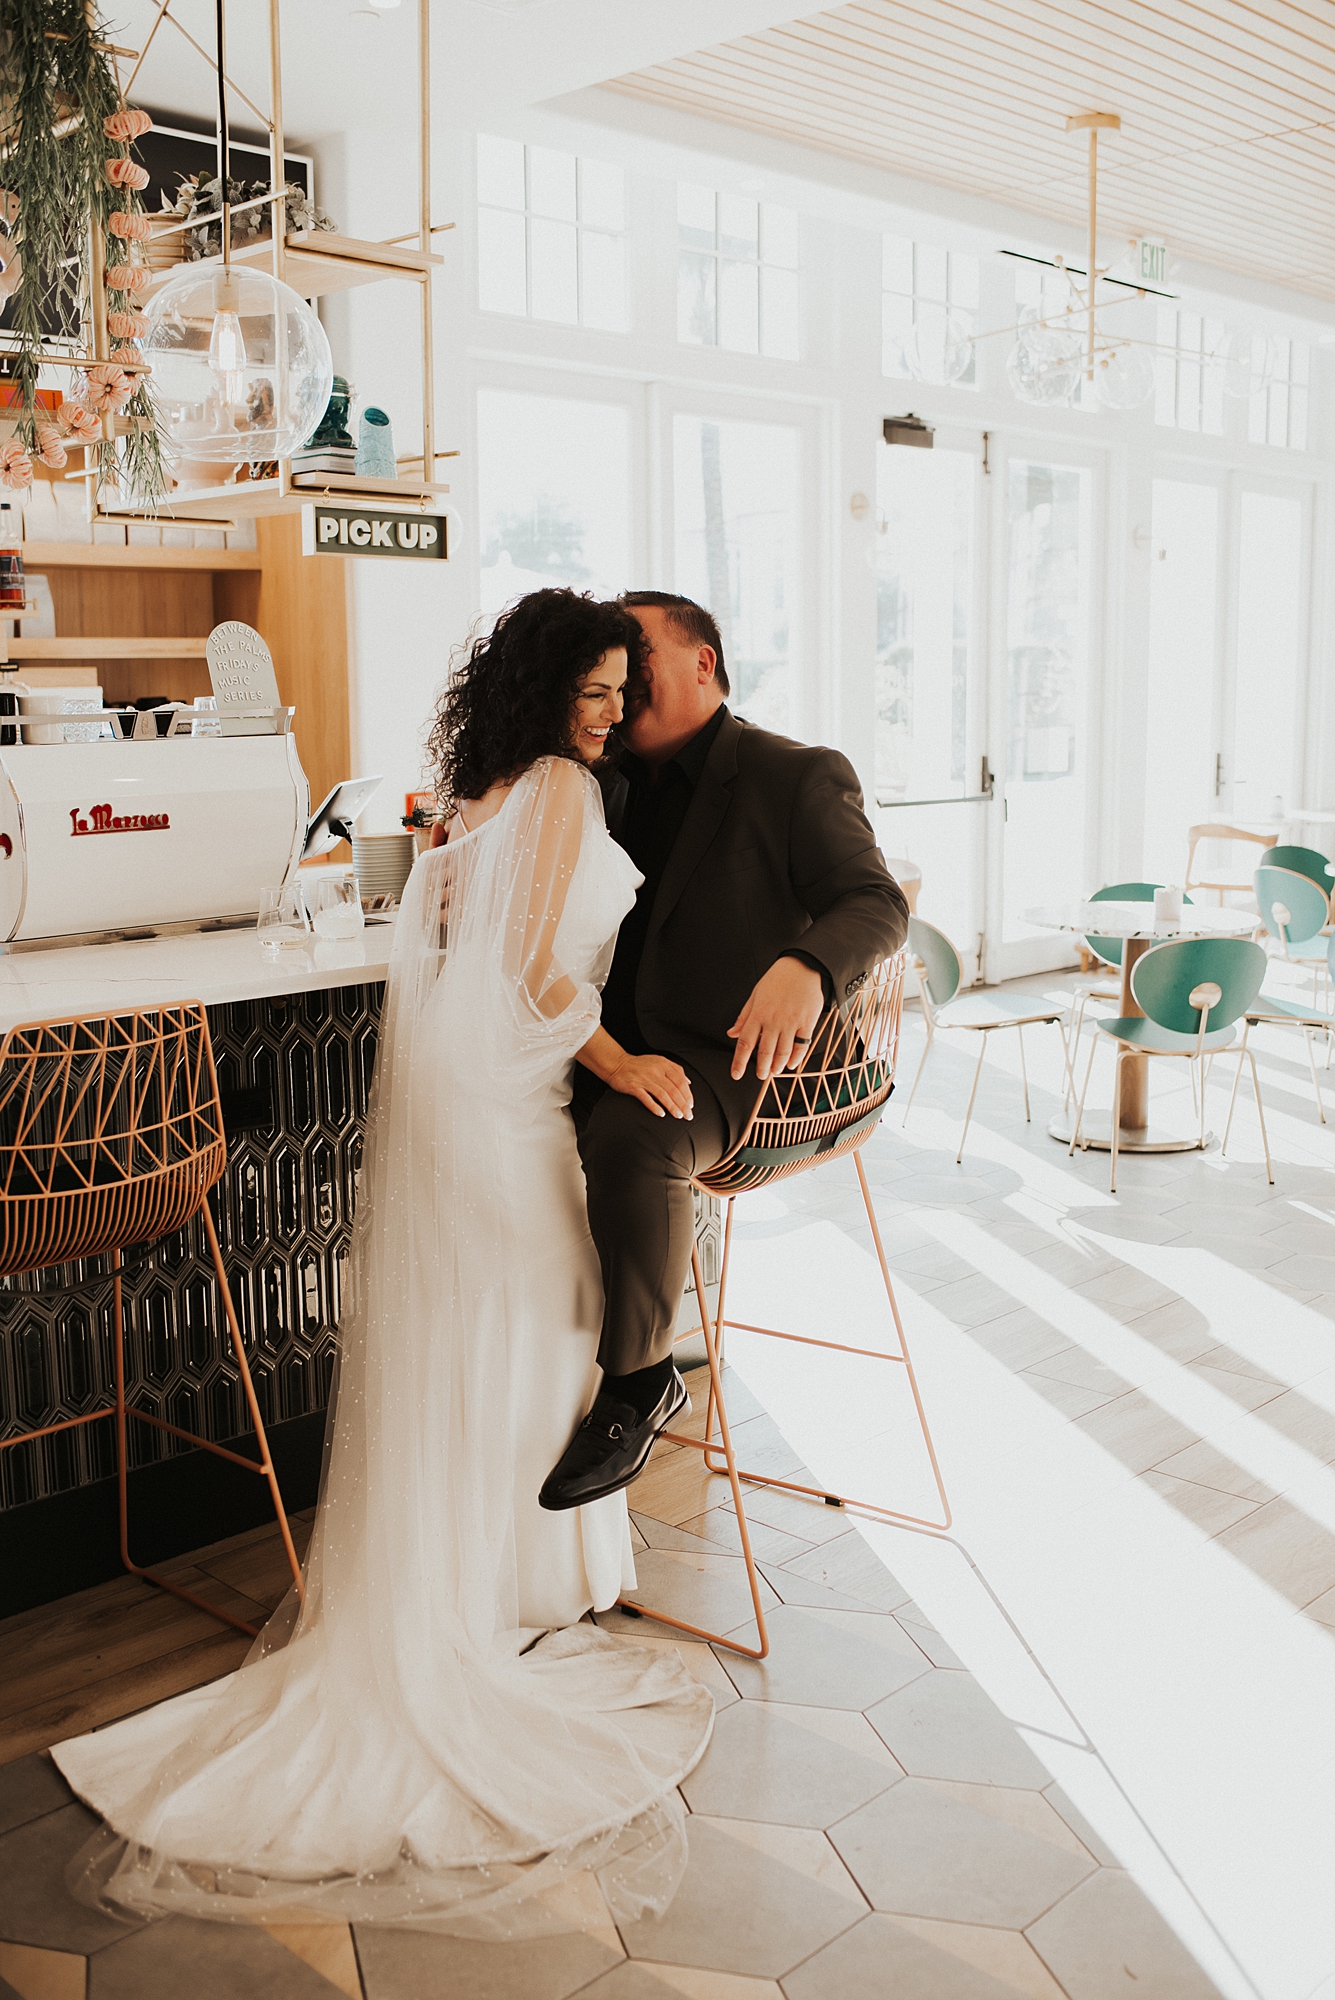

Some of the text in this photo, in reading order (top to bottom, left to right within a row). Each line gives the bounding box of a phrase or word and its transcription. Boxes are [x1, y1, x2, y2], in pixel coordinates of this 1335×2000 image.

[1141, 241, 1166, 282] EXIT
[318, 516, 438, 549] PICK UP
[210, 623, 259, 645] BETWEEN
[214, 640, 271, 663] THE PALMS
[216, 659, 260, 672] FRIDAYS
[217, 675, 251, 690] MUSIC
[223, 690, 264, 703] SERIES
[89, 803, 169, 831] Marzocco
